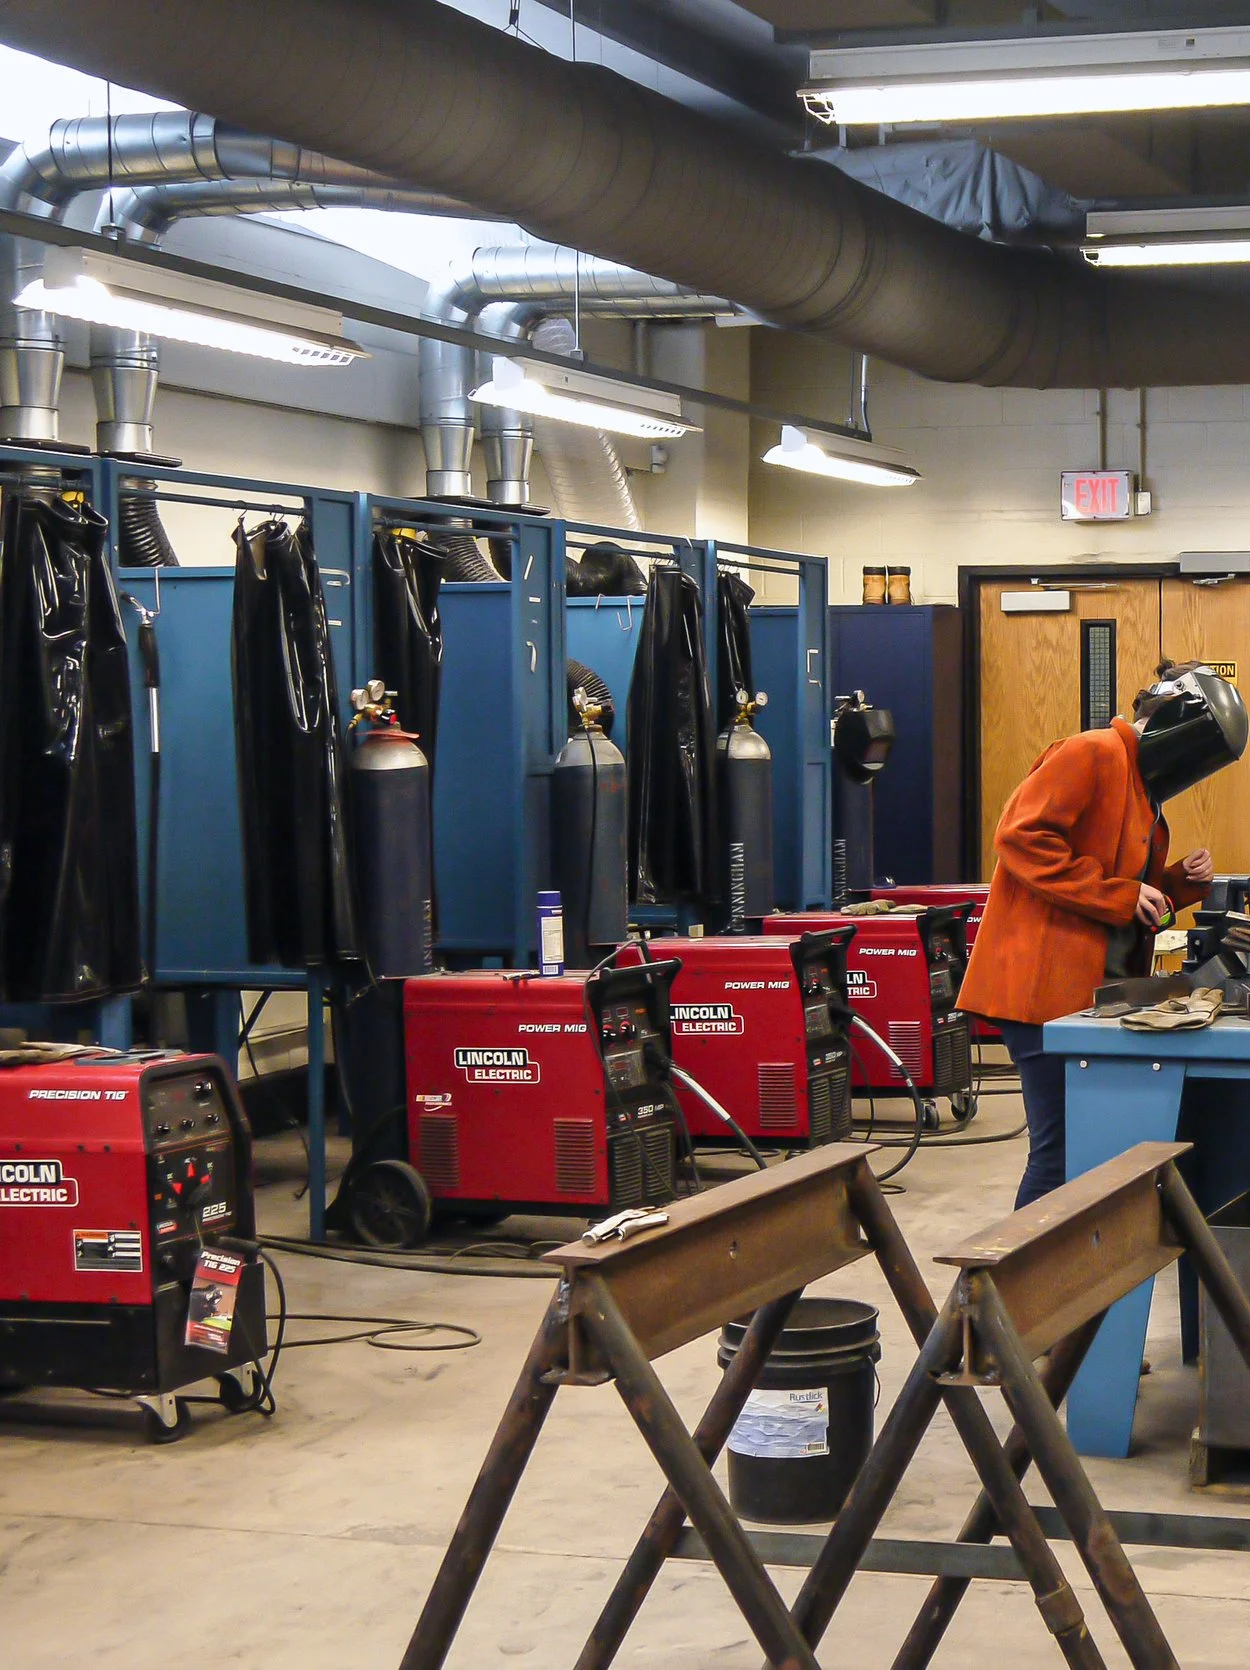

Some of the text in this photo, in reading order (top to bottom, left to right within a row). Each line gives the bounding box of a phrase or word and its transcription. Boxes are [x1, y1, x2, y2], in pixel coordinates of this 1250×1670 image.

[1074, 478, 1118, 513] EXIT
[858, 948, 917, 957] POWER MIG
[768, 981, 790, 989] MIG
[847, 986, 870, 996] TRIC
[670, 1006, 729, 1019] INCOLN
[518, 1024, 588, 1033] POWER MIG
[682, 1022, 737, 1032] ELECTRIC
[458, 1051, 524, 1066] LINCOLN
[474, 1069, 532, 1080] ELECTRIC
[29, 1090, 126, 1101] PRECISION TIG
[0, 1164, 56, 1183] COLN
[0, 1188, 68, 1202] LECTRIC
[202, 1201, 227, 1217] 225
[201, 1250, 241, 1267] Precision
[789, 1391, 823, 1401] Rustlick
